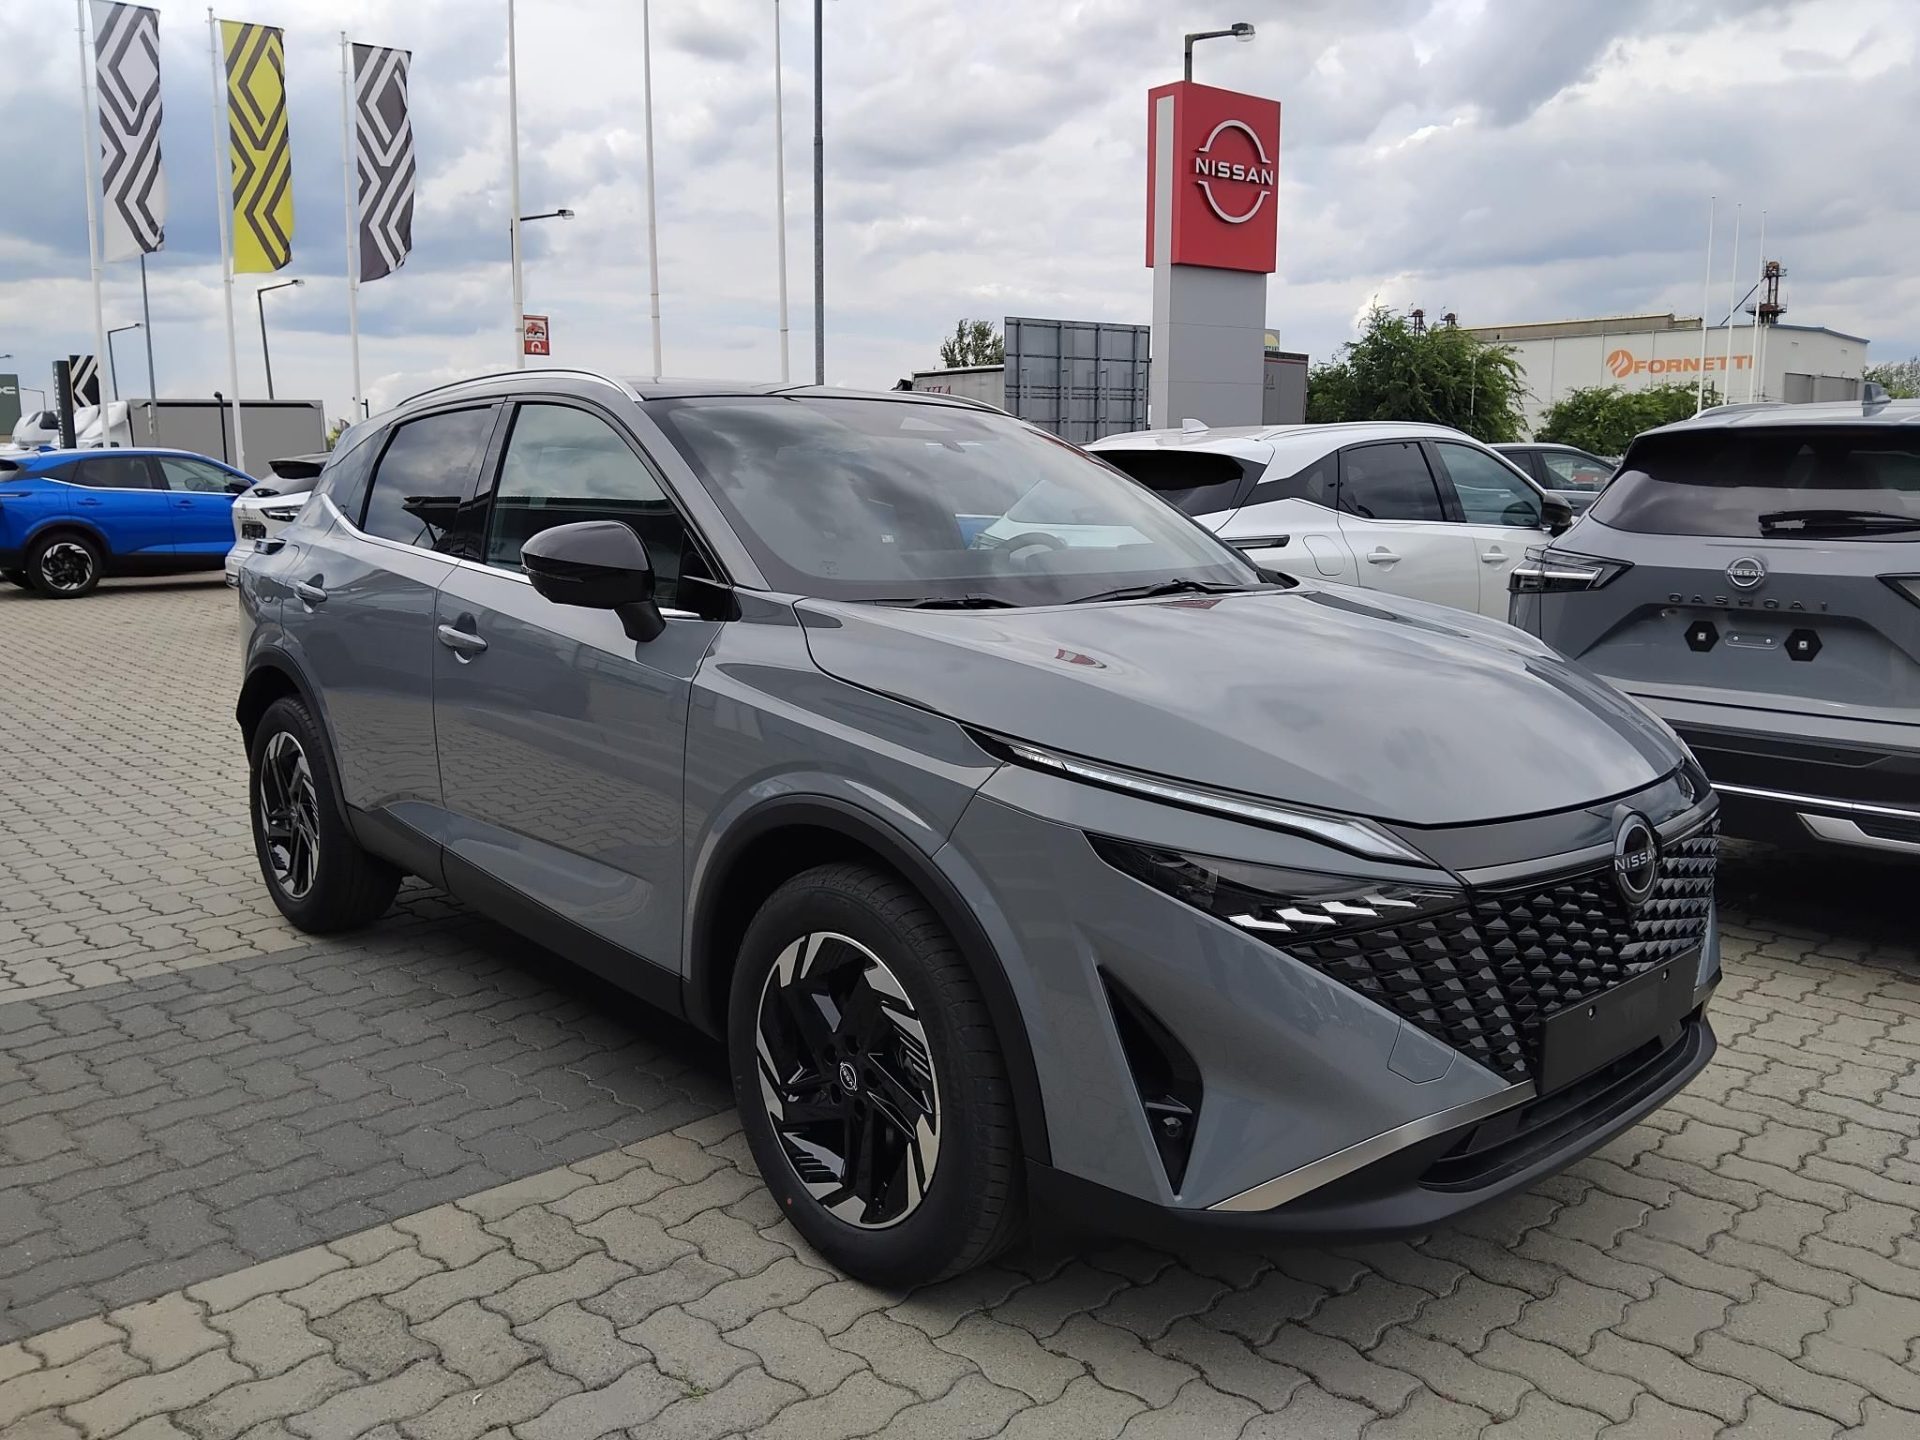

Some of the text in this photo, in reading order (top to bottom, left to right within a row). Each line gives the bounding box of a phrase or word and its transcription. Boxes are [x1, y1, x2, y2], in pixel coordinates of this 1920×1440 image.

[1195, 157, 1274, 186] NISSAN
[1633, 354, 1754, 374] FORNETTI
[1727, 568, 1765, 578] NISSAN
[1668, 592, 1829, 612] QASHQAI
[1614, 847, 1658, 871] NISSAN
